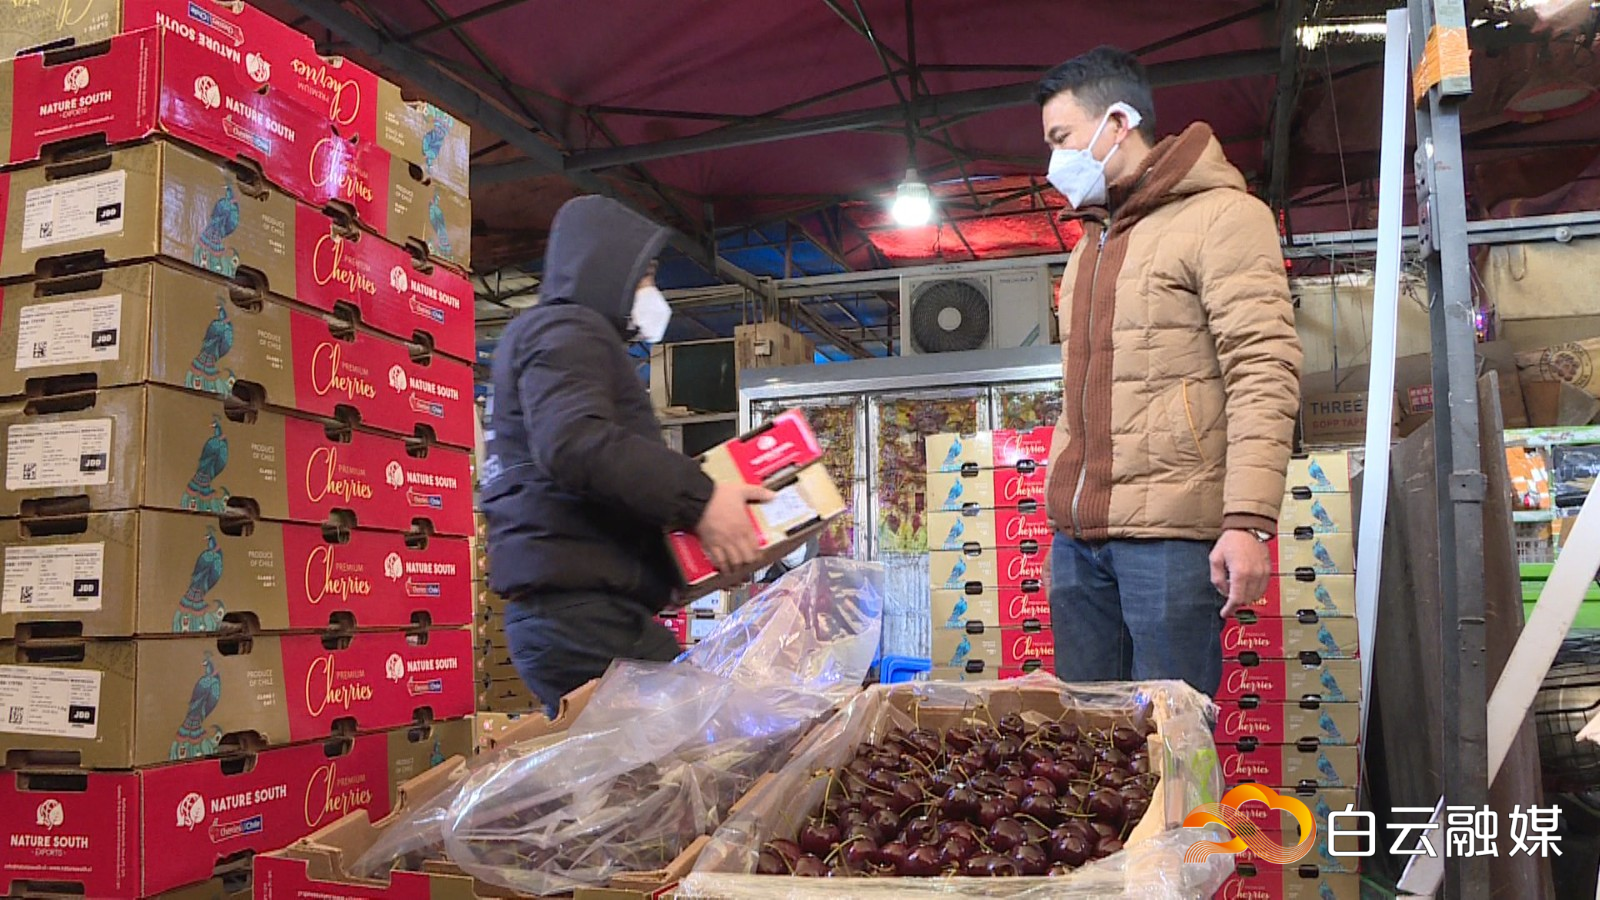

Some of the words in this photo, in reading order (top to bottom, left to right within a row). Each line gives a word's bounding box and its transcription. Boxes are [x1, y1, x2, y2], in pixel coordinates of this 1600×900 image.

[156, 10, 196, 41] SOUTH
[198, 32, 241, 64] NATURE
[40, 98, 77, 116] NATURE
[79, 90, 112, 107] SOUTH
[290, 58, 360, 125] Cherries
[225, 96, 263, 126] NATURE
[265, 117, 295, 143] SOUTH
[309, 137, 373, 202] Cherries
[313, 233, 377, 296] Cherries
[410, 279, 438, 301] NATURE
[438, 290, 460, 309] SOUTH
[311, 342, 377, 400] Cherries
[341, 361, 369, 376] PREMIUM
[409, 377, 436, 393] NATURE
[436, 384, 459, 400] SOUTH
[1310, 399, 1364, 415] THREE
[1003, 435, 1047, 459] Cherries
[306, 446, 374, 503] Cherries
[338, 464, 366, 477] PREMIUM
[406, 472, 435, 487] NATURE
[435, 475, 457, 489] SOUTH
[1005, 477, 1045, 501] Cherrie
[1006, 517, 1049, 541] Cherries
[305, 545, 371, 604] Cherries
[335, 562, 364, 573] PREMIUM
[405, 562, 433, 574] NATURE
[433, 562, 456, 575] SOUTH
[1008, 555, 1043, 581] Cherri
[1224, 625, 1270, 651] Cherries
[336, 669, 365, 680] PREMIUM
[407, 660, 434, 672] NATURE
[435, 657, 458, 669] SOUTH
[305, 654, 373, 717] Cherries
[1227, 669, 1273, 694] Cherries
[1225, 711, 1271, 735] Cherries
[1223, 753, 1270, 777] Cherries
[337, 774, 366, 786] PREMIUM
[211, 791, 252, 813] NATURE
[254, 784, 287, 804] SOUTH
[305, 762, 372, 827] Cherries
[10, 834, 51, 847] NATURE
[53, 835, 89, 849] SOUTH
